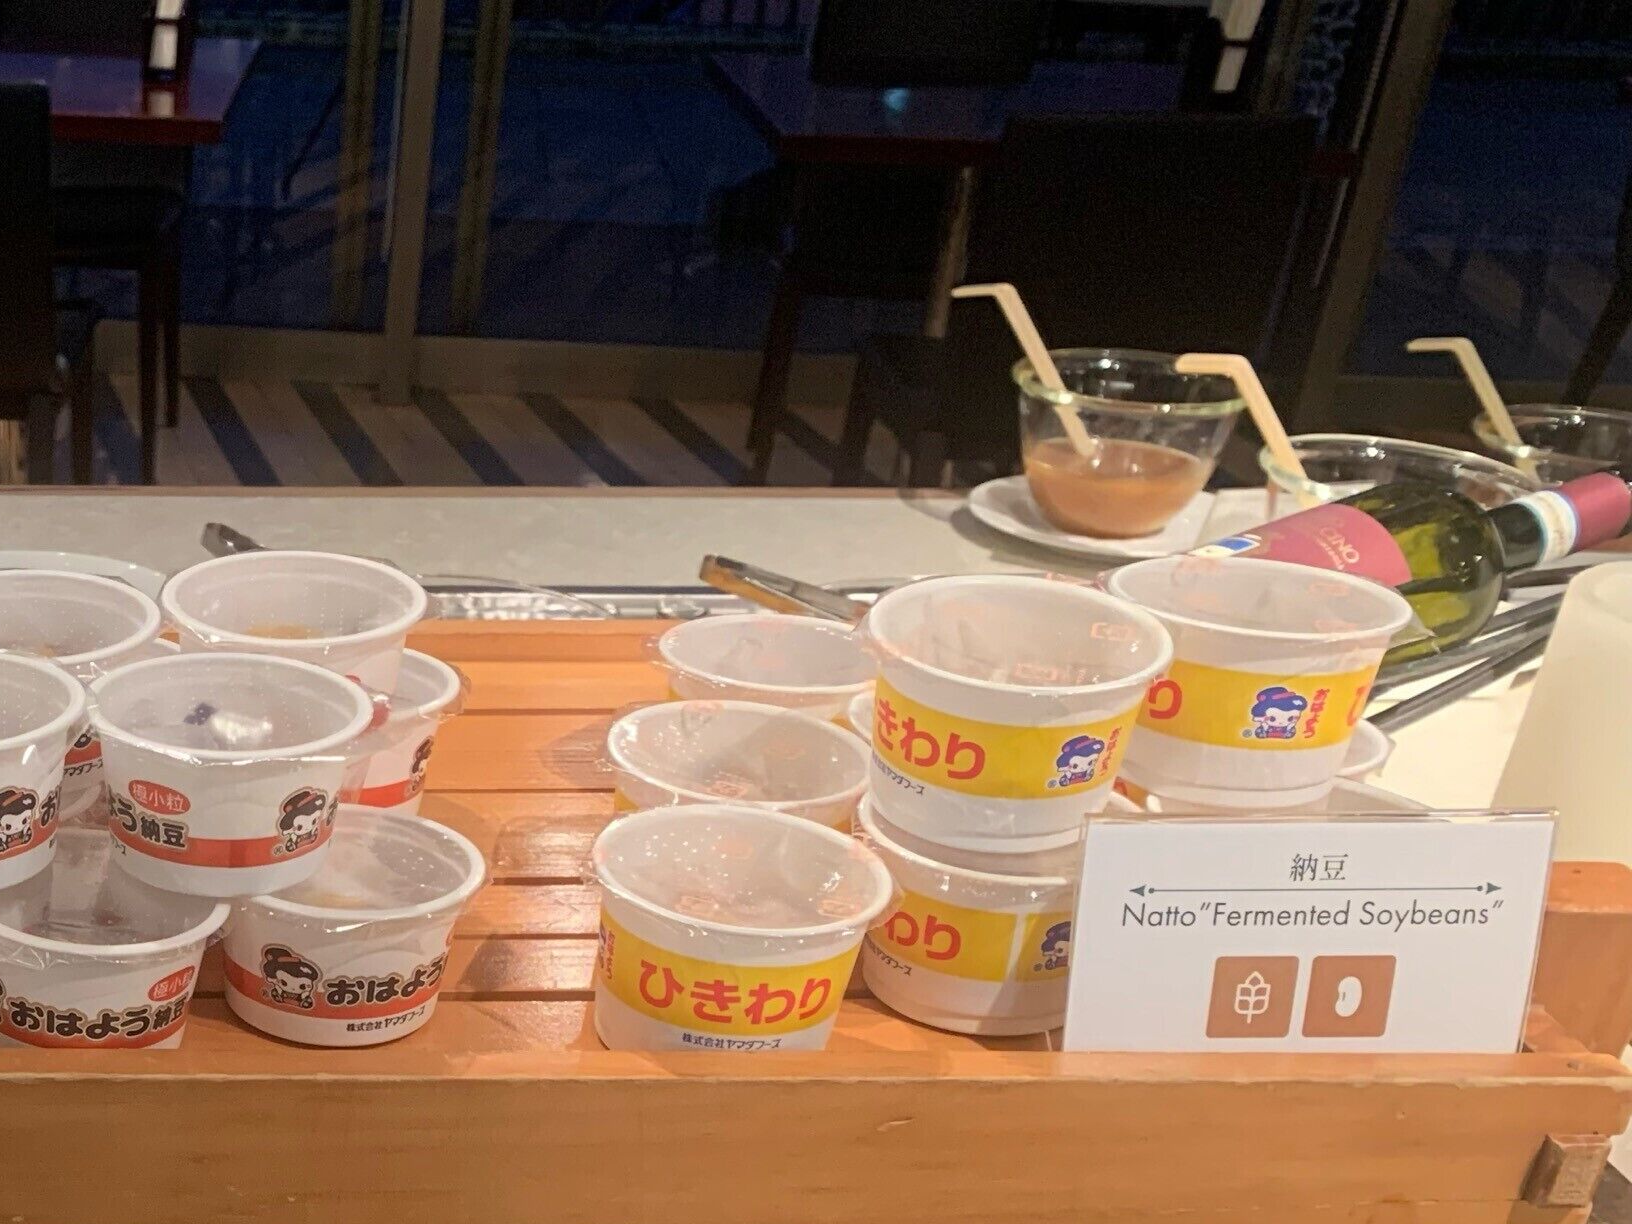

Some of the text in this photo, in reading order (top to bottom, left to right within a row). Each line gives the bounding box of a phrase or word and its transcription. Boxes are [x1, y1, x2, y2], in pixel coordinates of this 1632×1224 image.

[1289, 853, 1349, 882] 納豆
[638, 959, 832, 1025] ひきわり
[10, 996, 187, 1038] おはよう納豆
